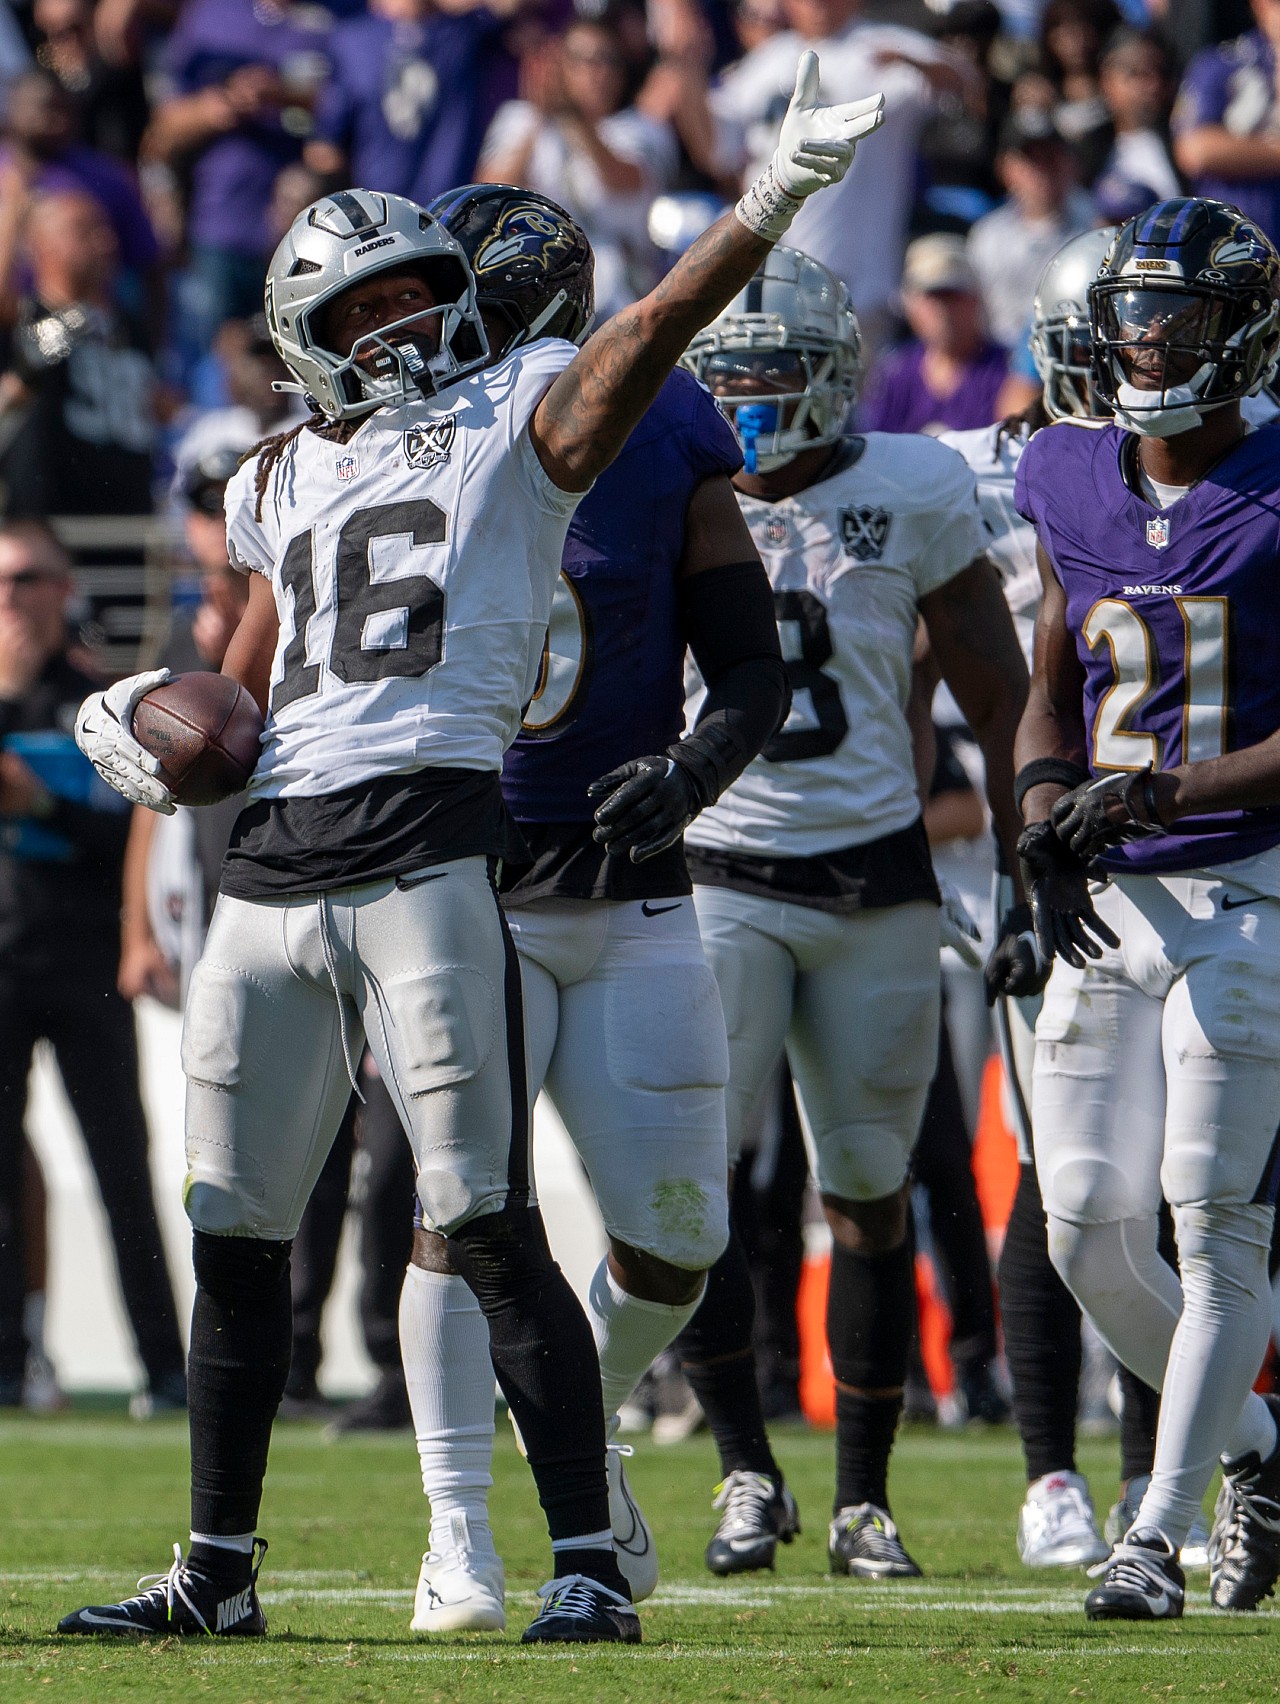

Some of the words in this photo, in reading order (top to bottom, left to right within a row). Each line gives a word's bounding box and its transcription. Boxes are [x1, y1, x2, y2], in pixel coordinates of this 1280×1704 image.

[354, 236, 395, 258] RAIDERS
[338, 465, 358, 479] NFL
[1148, 530, 1167, 543] NFL
[1122, 584, 1184, 596] RAVENS
[272, 498, 447, 716] 16
[1081, 597, 1230, 774] 21
[215, 1584, 253, 1633] NIKE
